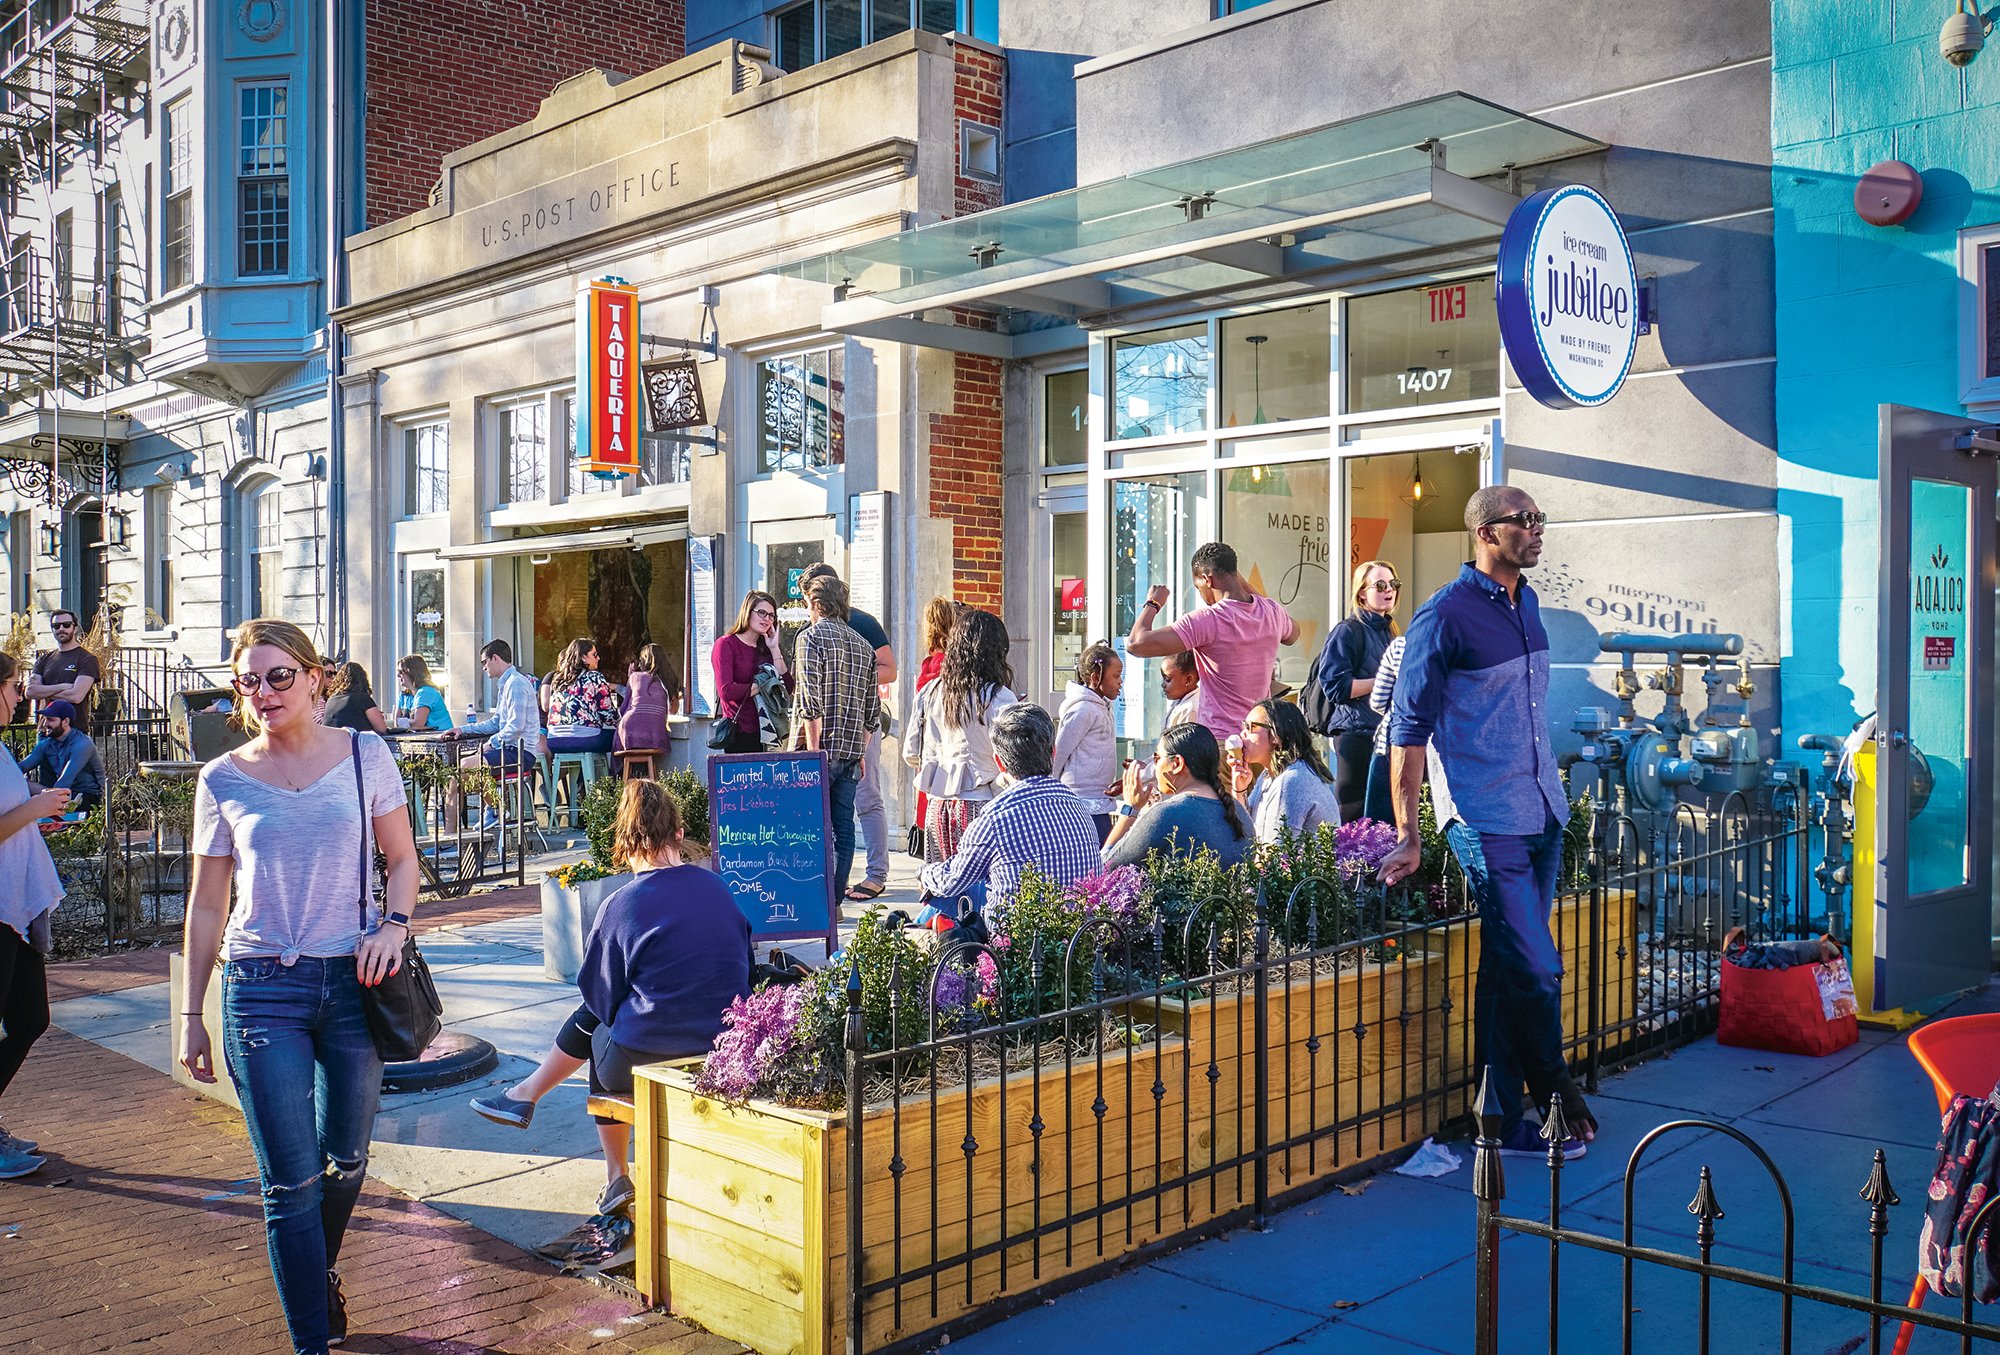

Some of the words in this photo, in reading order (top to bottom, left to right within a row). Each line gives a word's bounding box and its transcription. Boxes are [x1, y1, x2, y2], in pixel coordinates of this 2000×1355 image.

[589, 161, 680, 212] OFFICE
[1563, 231, 1577, 253] ice
[1578, 239, 1607, 262] cream
[1540, 254, 1628, 328] jubilee
[1560, 334, 1576, 347] MADE
[1578, 338, 1586, 350] BY
[1587, 340, 1612, 355] FRIENDS
[1568, 353, 1597, 367] WASHINGTON
[1597, 359, 1604, 368] DC
[607, 303, 625, 452] TAQUERIA
[1397, 368, 1452, 395] 1407
[1268, 512, 1311, 532] MADE
[720, 765, 764, 785] Limited
[766, 761, 789, 784] Time
[791, 760, 821, 783] Flavors
[717, 794, 737, 812] Tres
[719, 824, 757, 843] Mexican
[759, 823, 776, 841] Hot
[719, 853, 765, 872] Cardamom
[729, 880, 763, 894] COME
[759, 891, 776, 902] ON
[769, 904, 796, 918] IN
